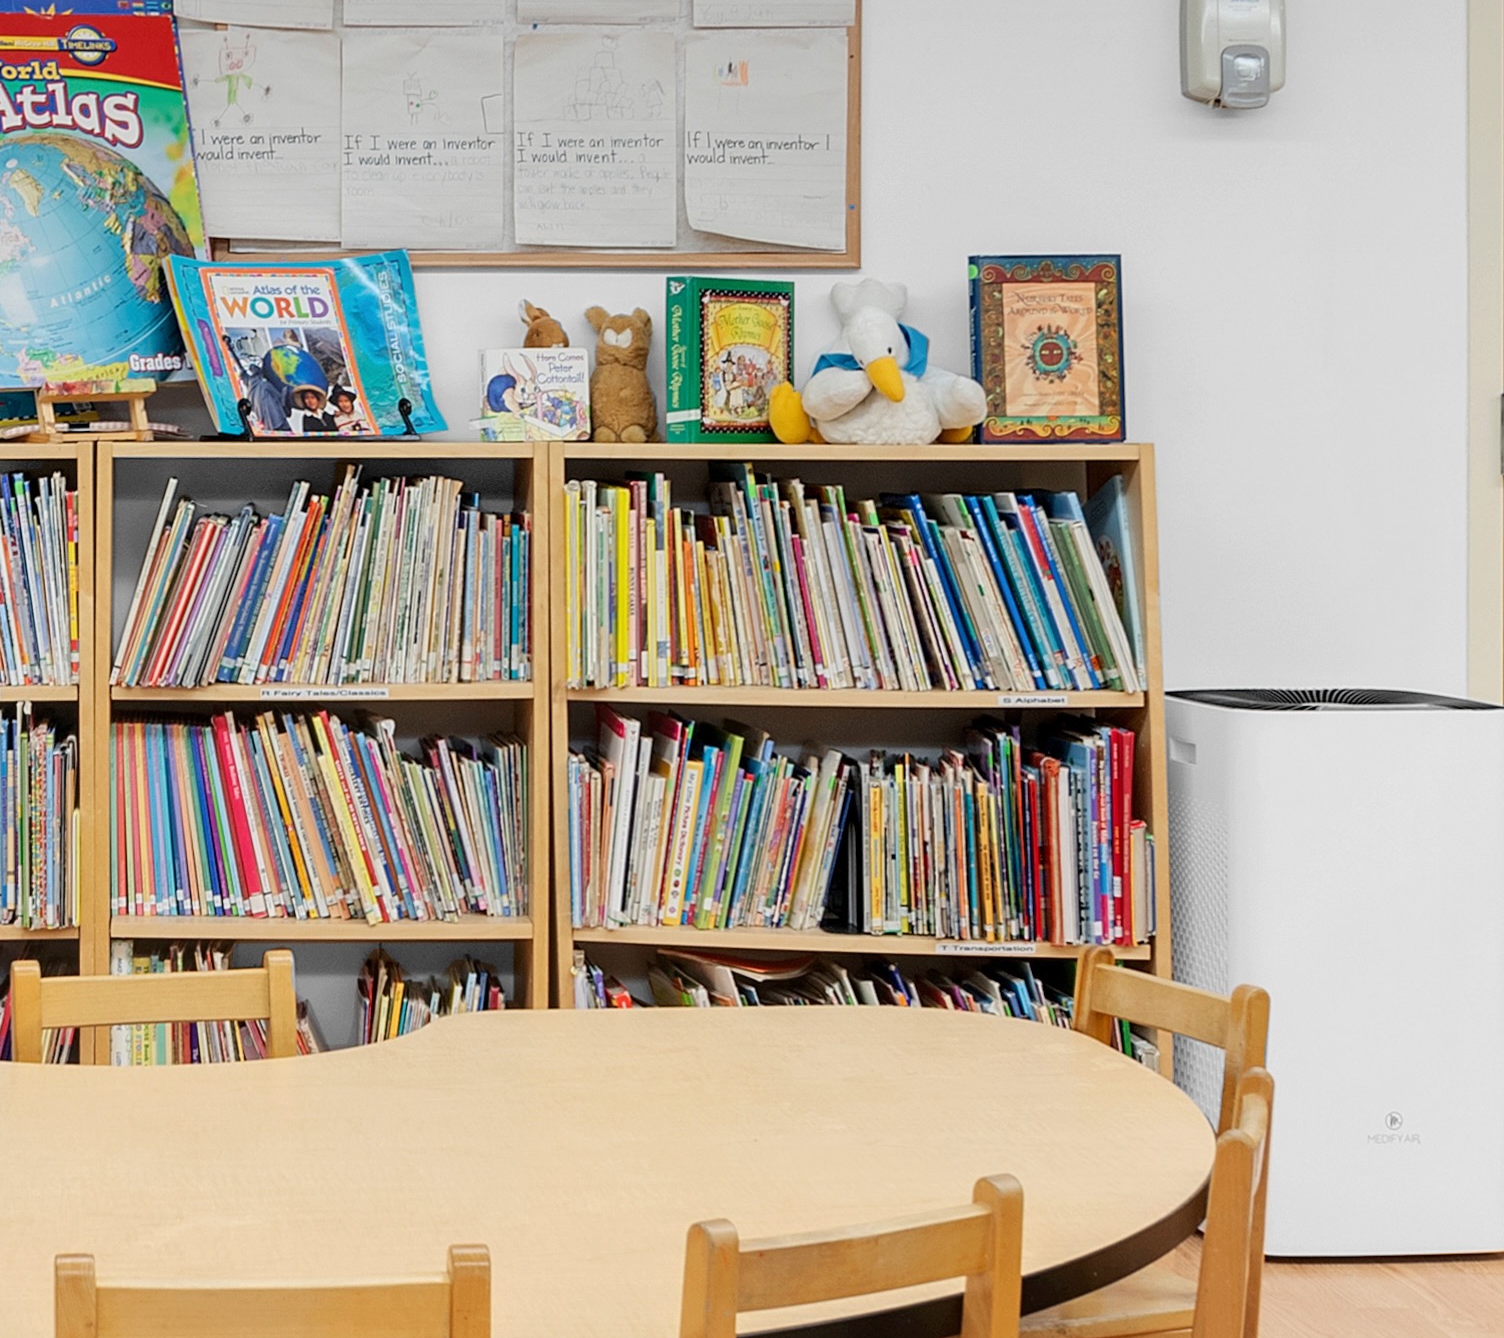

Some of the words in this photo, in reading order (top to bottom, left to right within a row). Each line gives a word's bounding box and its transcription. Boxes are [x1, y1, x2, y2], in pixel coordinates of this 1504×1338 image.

[61, 39, 112, 51] TIMELINKS
[345, 135, 362, 150] If
[370, 135, 380, 151] I
[387, 140, 417, 150] were
[422, 139, 437, 150] an
[344, 152, 353, 166] I
[358, 153, 390, 165] would
[49, 274, 112, 309] Atlantic
[253, 284, 282, 295] Atlas
[284, 284, 297, 295] of
[300, 285, 320, 295] the
[220, 296, 329, 319] WORLD
[377, 270, 397, 330] STUDIES
[129, 354, 181, 372] Grades
[389, 331, 407, 385] SOCIAL
[536, 353, 557, 362] Here
[559, 353, 584, 362] Comes
[549, 363, 574, 373] Peter
[536, 374, 585, 385] Cottontail!
